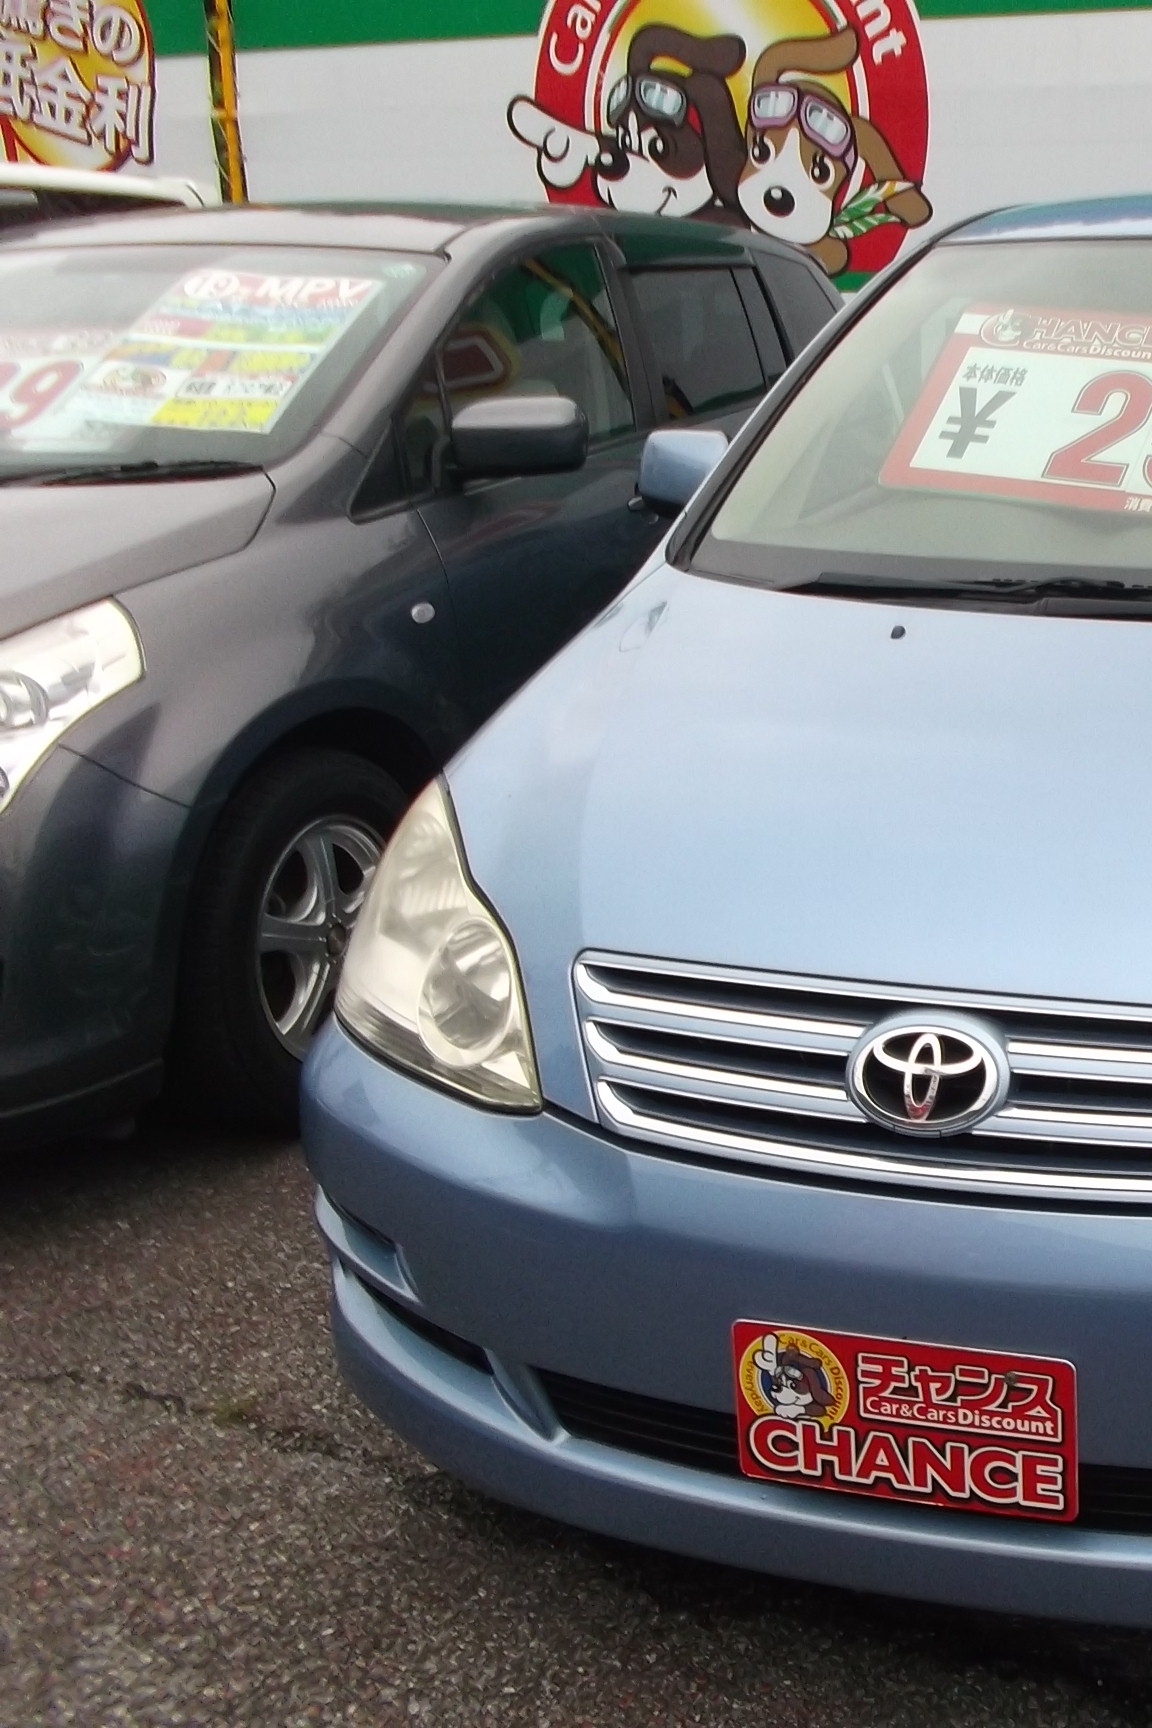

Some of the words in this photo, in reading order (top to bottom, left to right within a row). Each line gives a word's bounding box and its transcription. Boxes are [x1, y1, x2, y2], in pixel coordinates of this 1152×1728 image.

[850, 0, 907, 66] nt
[963, 363, 1028, 387] 本体価格
[938, 386, 1017, 460] ¥
[857, 1352, 1060, 1418] チャンス
[750, 1414, 1065, 1510] CHANCE
